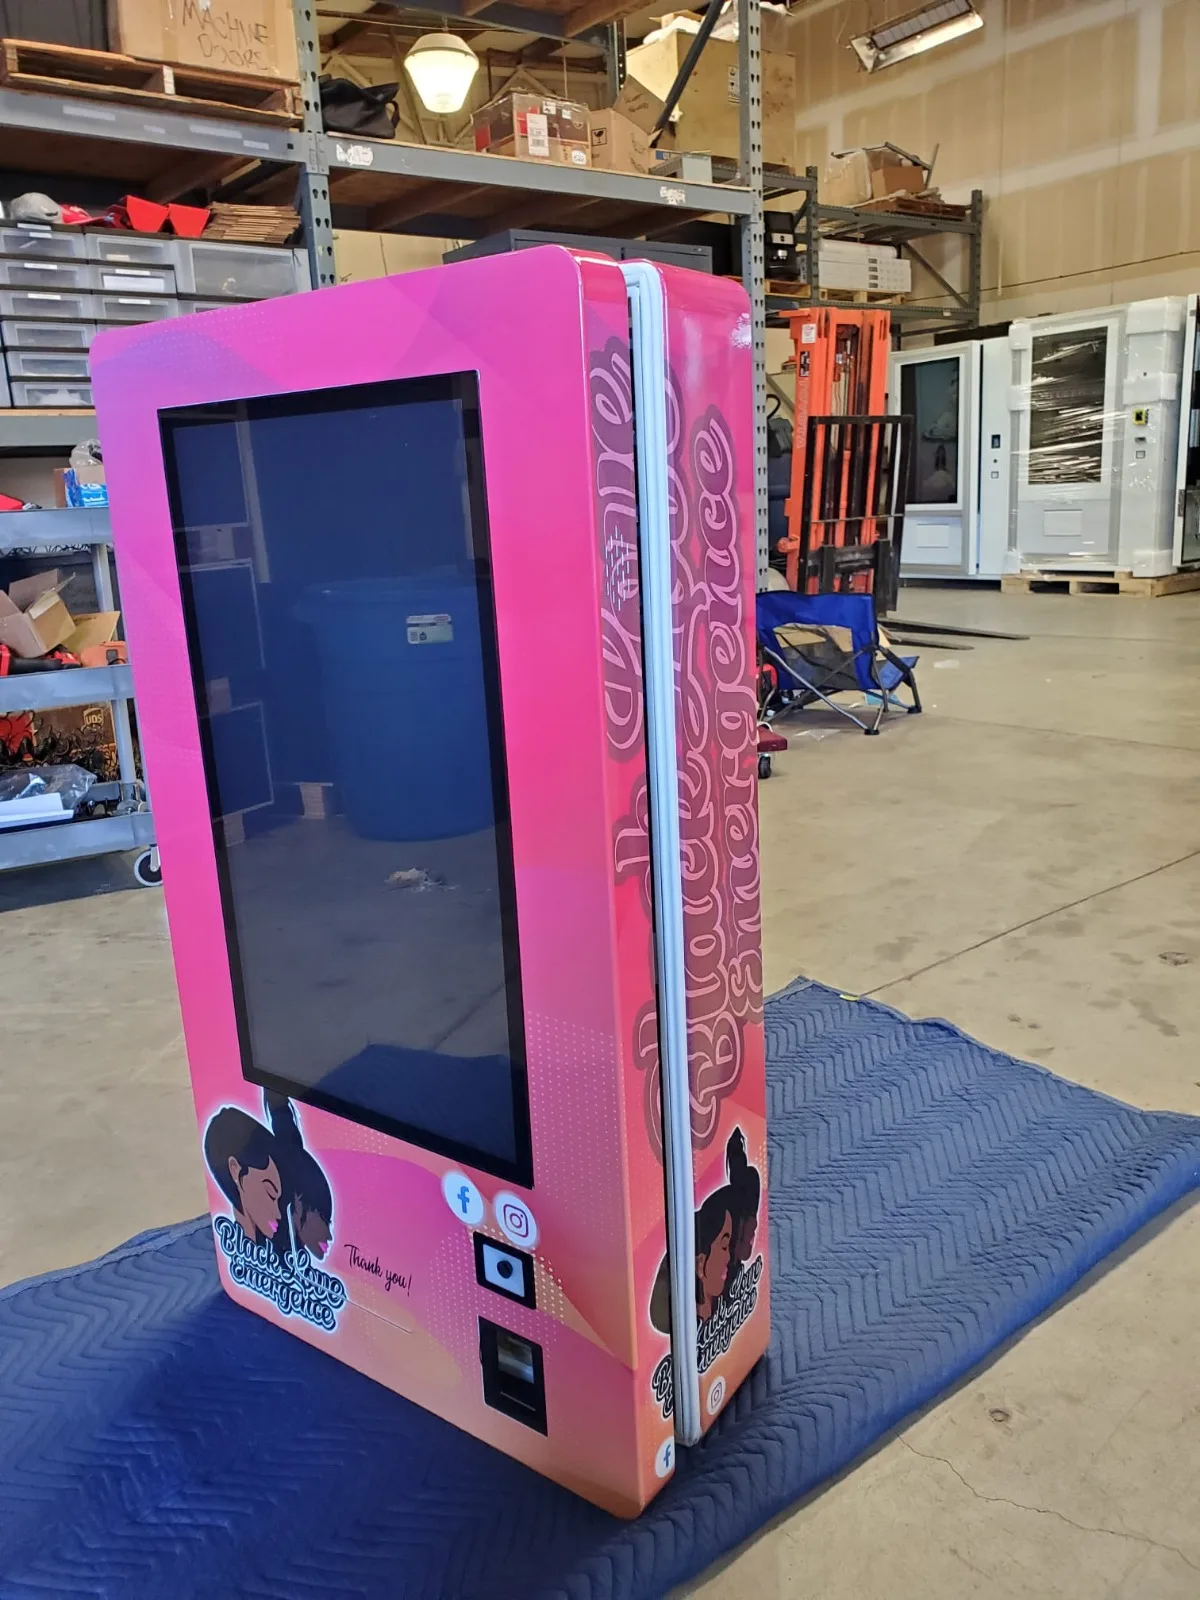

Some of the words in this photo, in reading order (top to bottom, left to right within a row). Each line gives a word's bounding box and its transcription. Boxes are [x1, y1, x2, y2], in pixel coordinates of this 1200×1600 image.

[182, 0, 269, 46] MACHINE
[197, 33, 268, 70] DOORS
[693, 418, 763, 1018] Emergence
[214, 1215, 282, 1274] Black
[284, 1250, 347, 1310] Love
[230, 1254, 336, 1331] Emergence
[343, 1243, 383, 1279] Thank
[385, 1267, 413, 1297] you!
